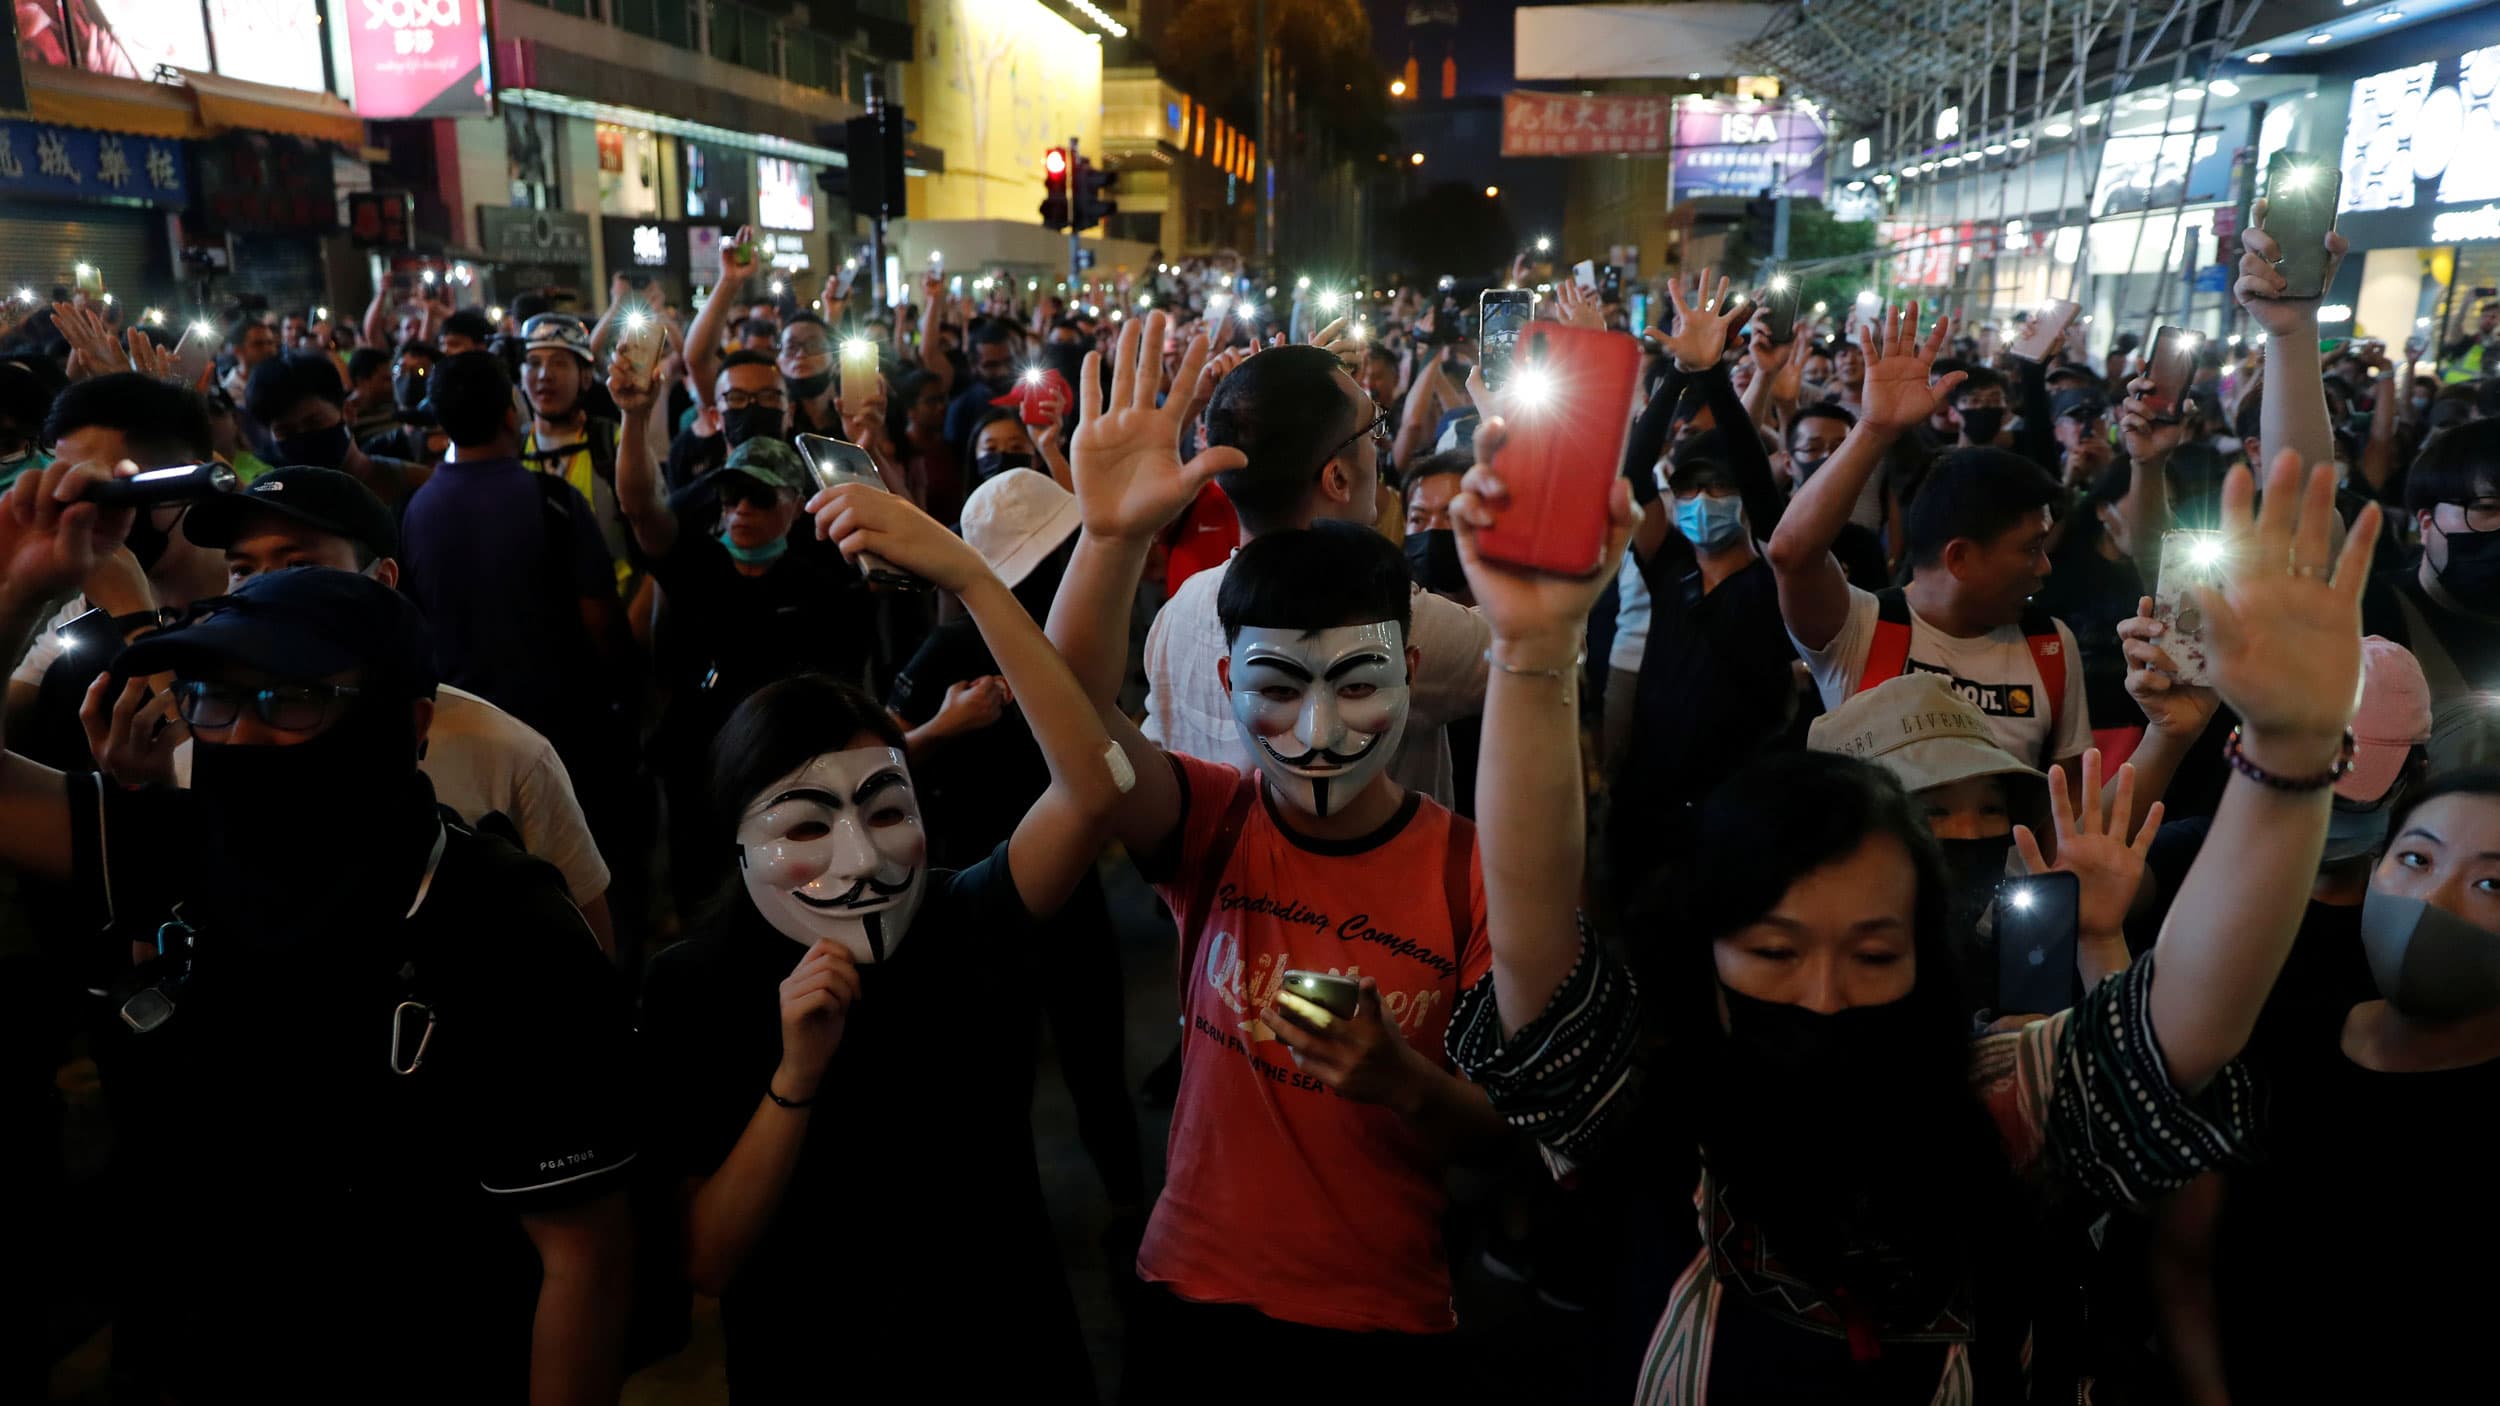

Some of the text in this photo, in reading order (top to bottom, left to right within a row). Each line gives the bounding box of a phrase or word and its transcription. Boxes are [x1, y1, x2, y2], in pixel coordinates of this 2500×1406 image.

[1721, 113, 1778, 143] ISA
[1337, 914, 1458, 980] Company
[1195, 1015, 1225, 1046] BORN
[1228, 1035, 1260, 1071] FRM
[1292, 1071, 1323, 1093] SEA
[539, 1149, 594, 1172] PGA TOUR
